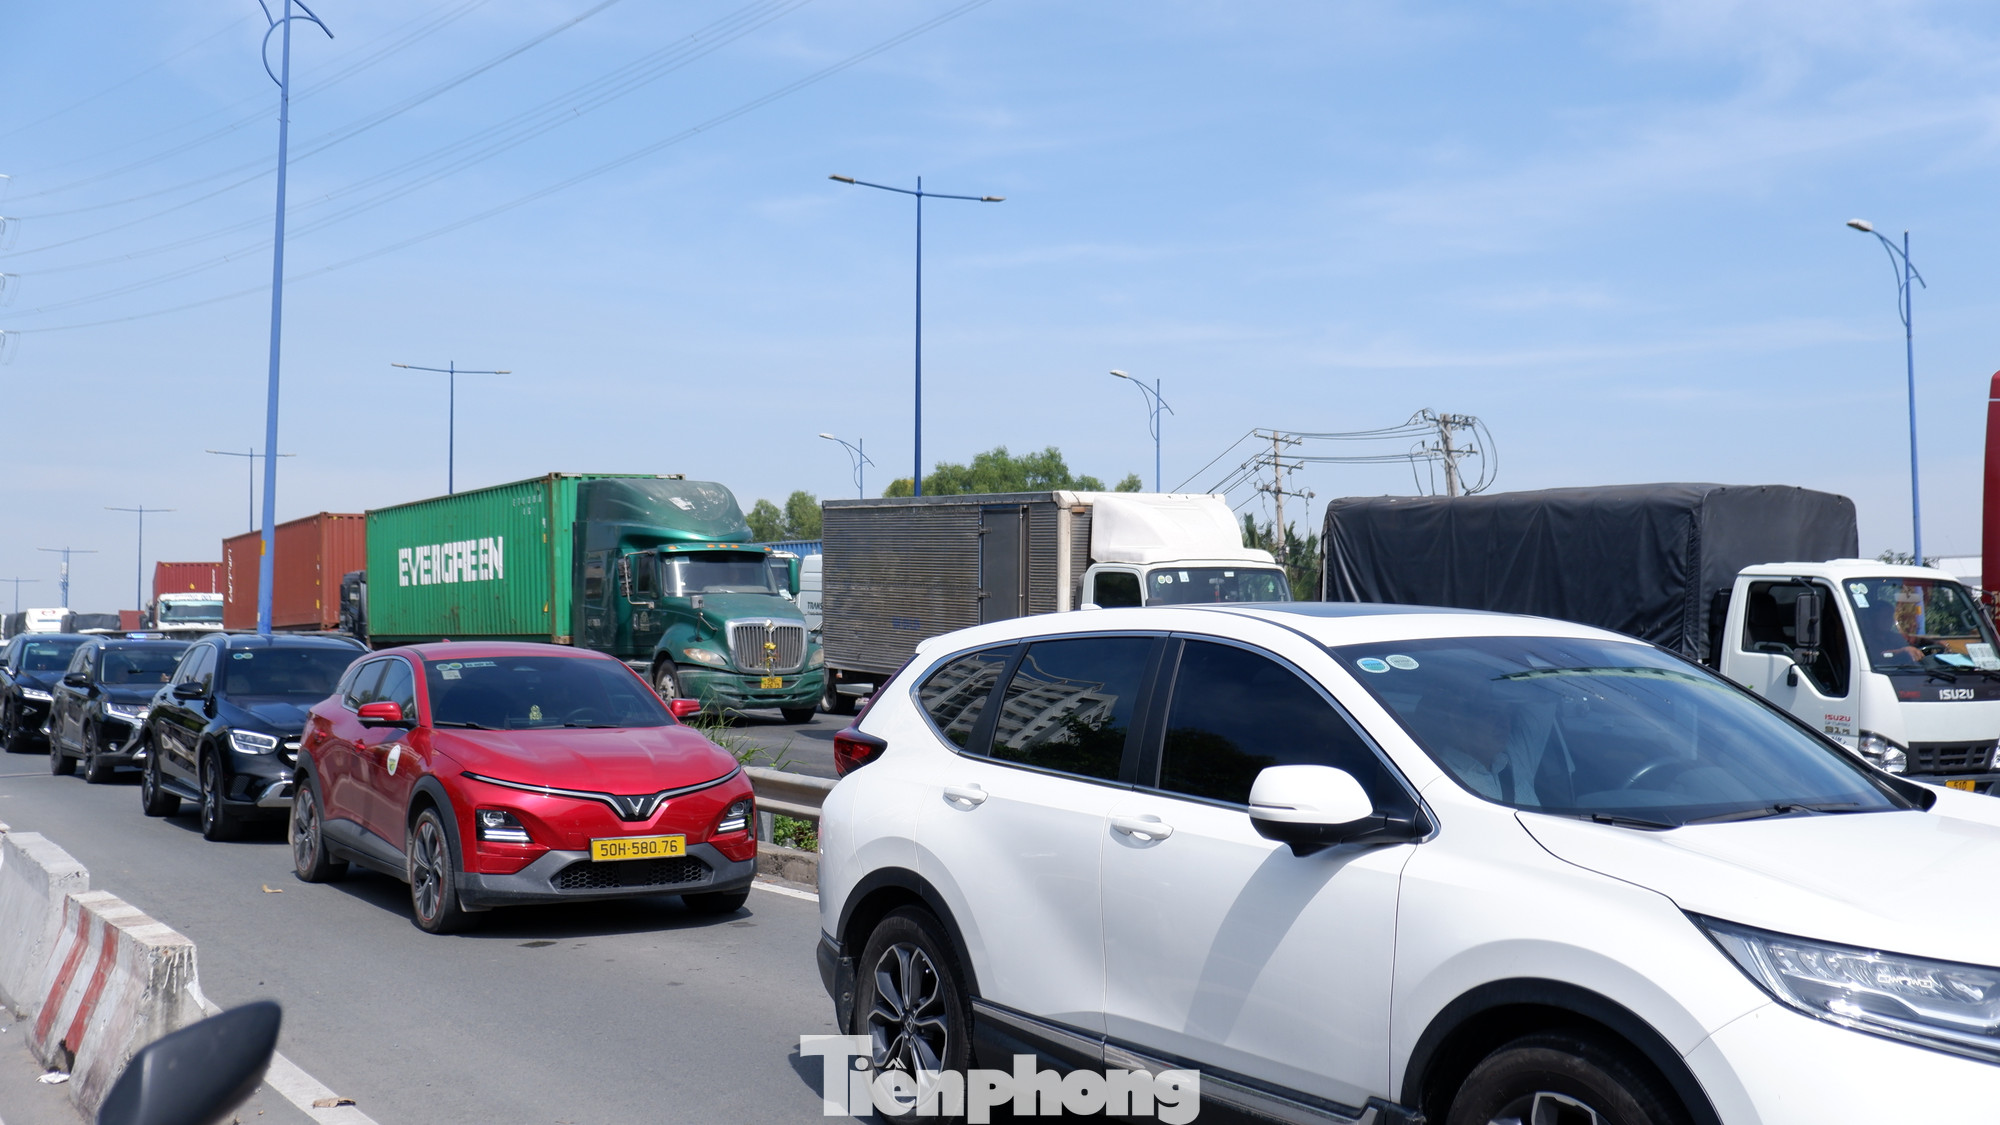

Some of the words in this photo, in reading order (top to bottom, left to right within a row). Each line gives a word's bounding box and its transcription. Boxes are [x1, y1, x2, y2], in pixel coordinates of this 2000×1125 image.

[399, 536, 503, 587] EVERGREEN
[1939, 688, 1975, 700] ISUZU
[1824, 714, 1851, 722] ISUZU
[600, 840, 678, 857] 50H-580.76
